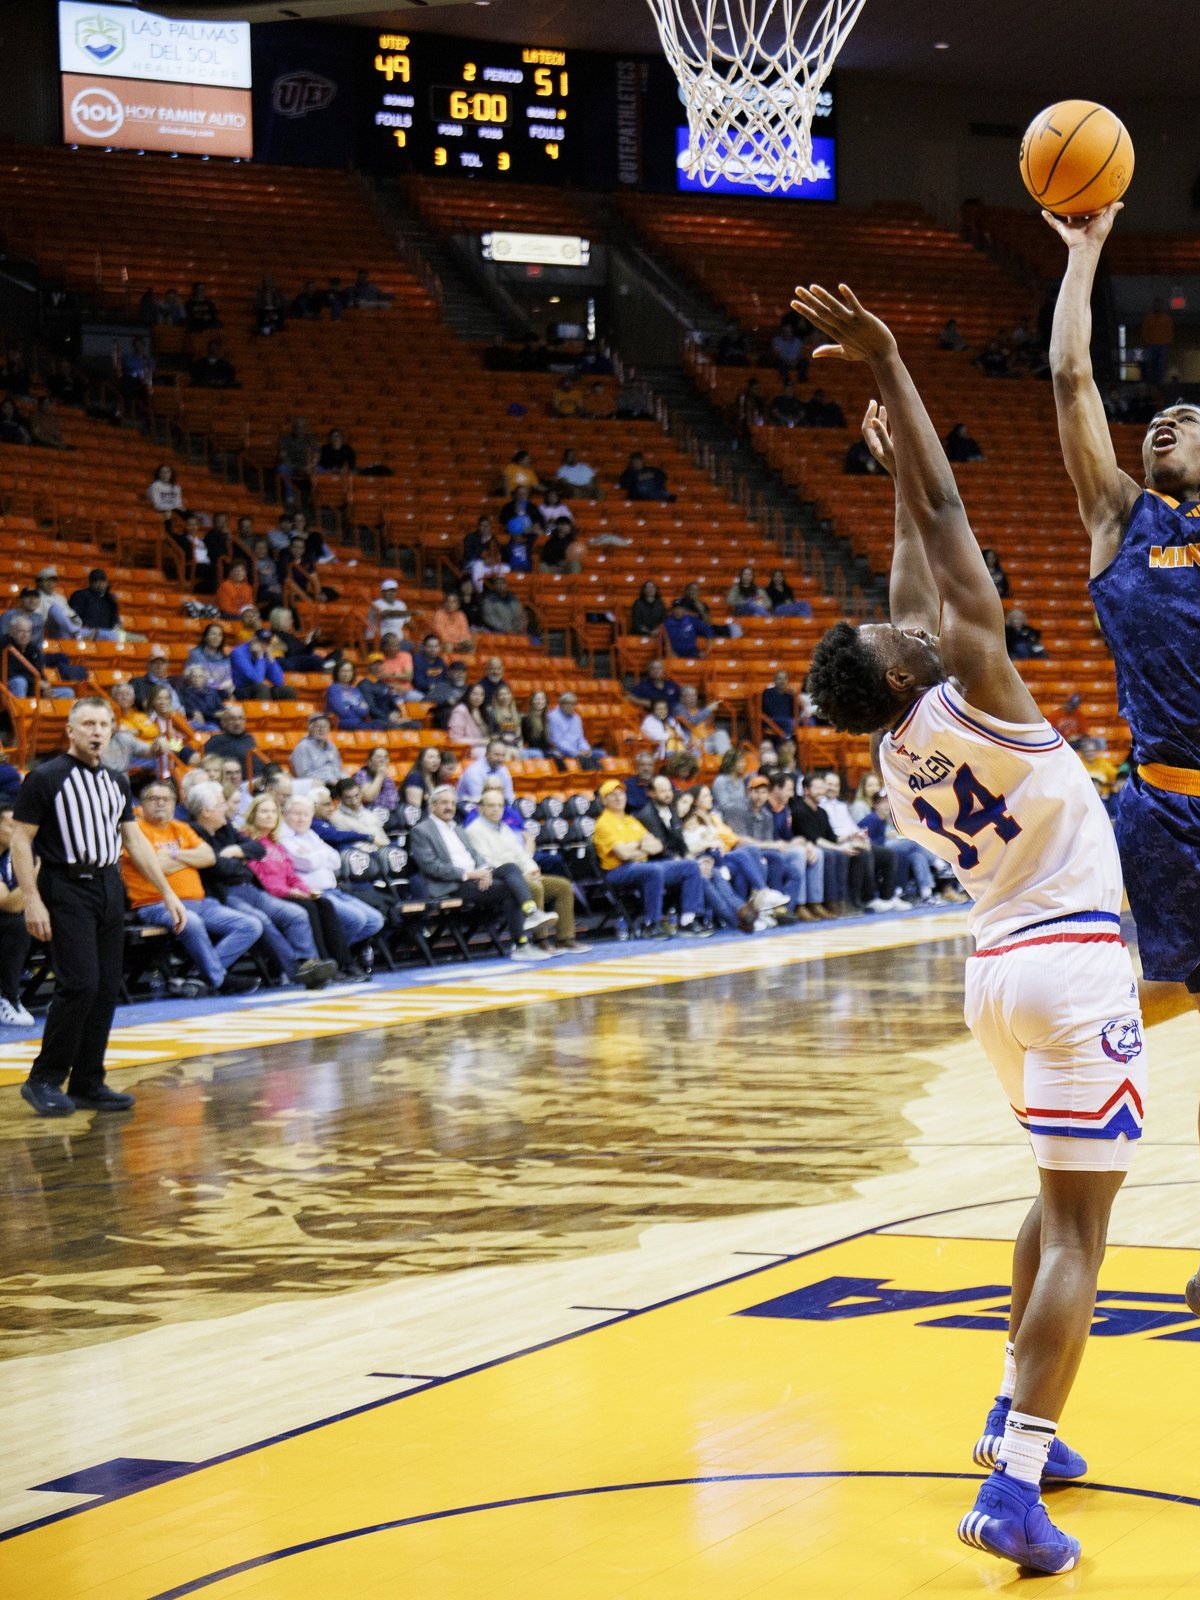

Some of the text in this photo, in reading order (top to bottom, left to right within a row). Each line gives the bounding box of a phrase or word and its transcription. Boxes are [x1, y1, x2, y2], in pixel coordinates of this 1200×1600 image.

[131, 18, 239, 44] LAS PALMAS
[379, 35, 410, 51] UTEP
[150, 43, 221, 65] DEL SOL
[374, 54, 410, 82] 49
[463, 62, 524, 84] 2 PERIOD
[534, 67, 569, 97] 51
[275, 78, 335, 115] UTEP
[450, 91, 507, 122] 6:00
[125, 104, 246, 127] HOY FAMILY AUTO
[375, 111, 413, 128] FOULS
[393, 129, 406, 148] 7
[528, 124, 566, 140] FOULS
[434, 146, 448, 166] 3
[497, 151, 511, 171] 3
[908, 749, 955, 794] ALLEN
[911, 761, 1023, 871] 14
